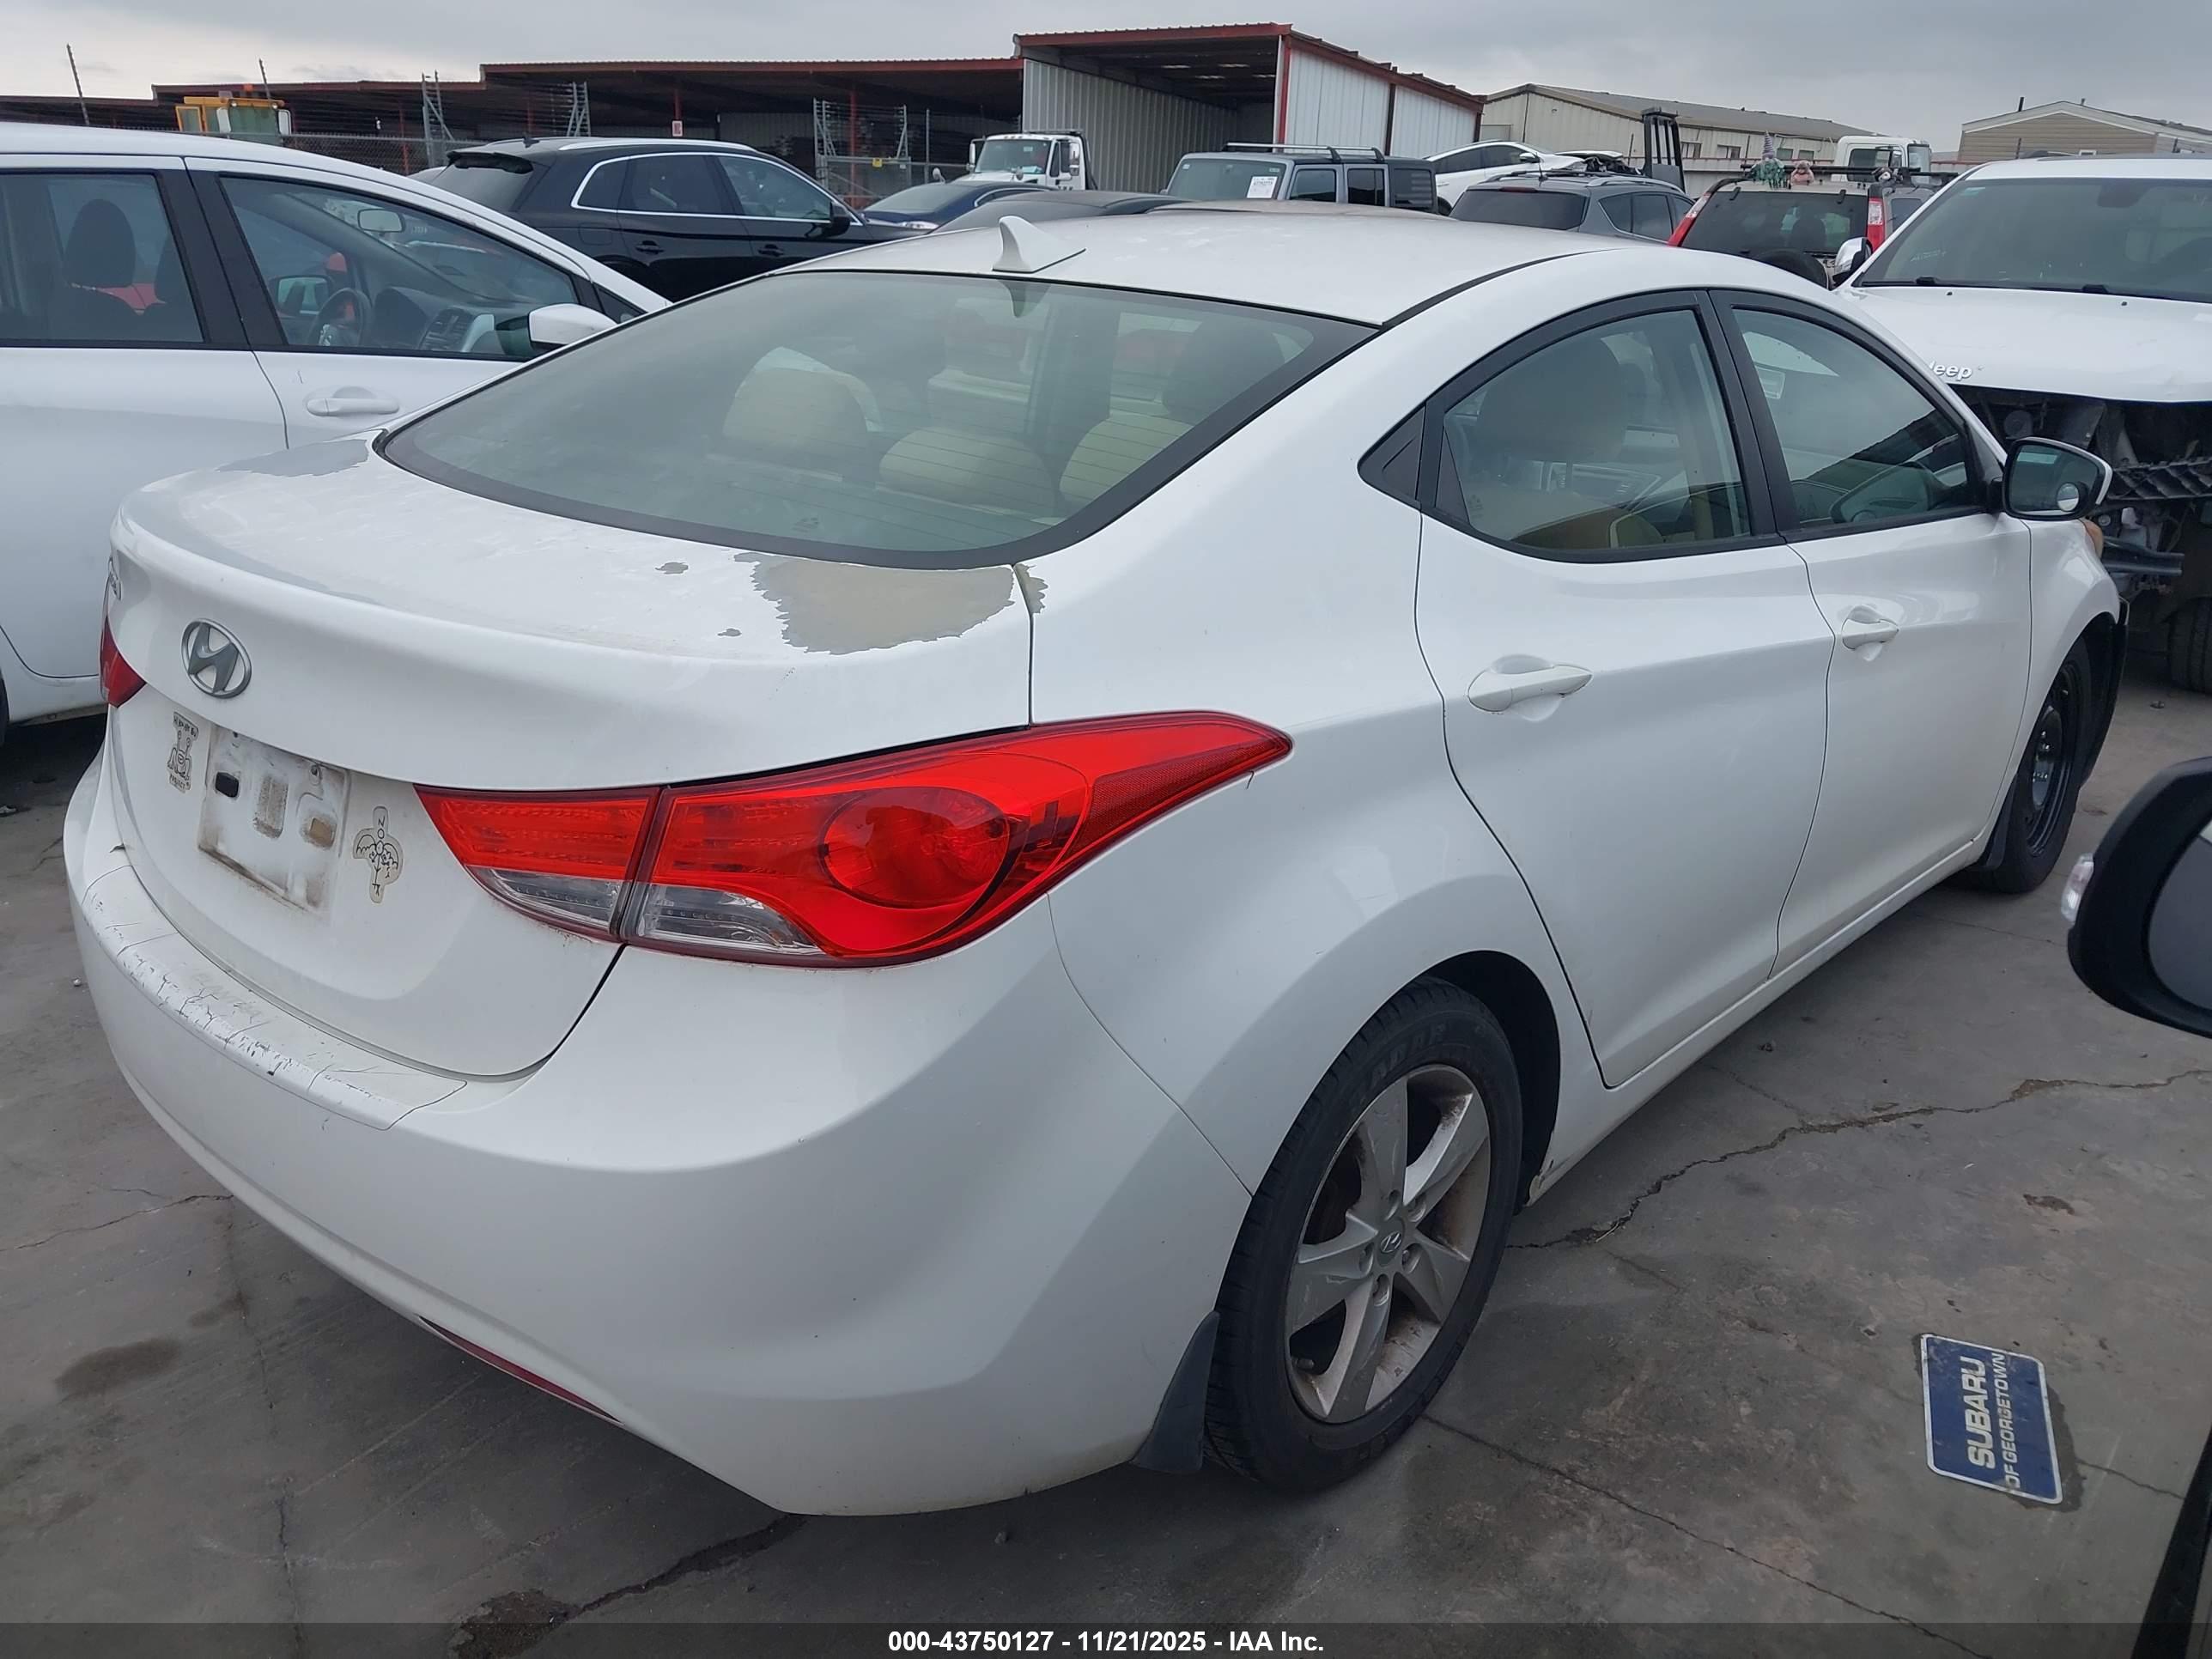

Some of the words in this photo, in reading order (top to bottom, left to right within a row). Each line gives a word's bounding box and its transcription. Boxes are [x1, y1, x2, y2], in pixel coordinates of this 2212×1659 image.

[1960, 1356, 1996, 1469] SUBARU
[1991, 1352, 2018, 1463] GEORGETOWN
[2004, 1463, 2021, 1488] OF
